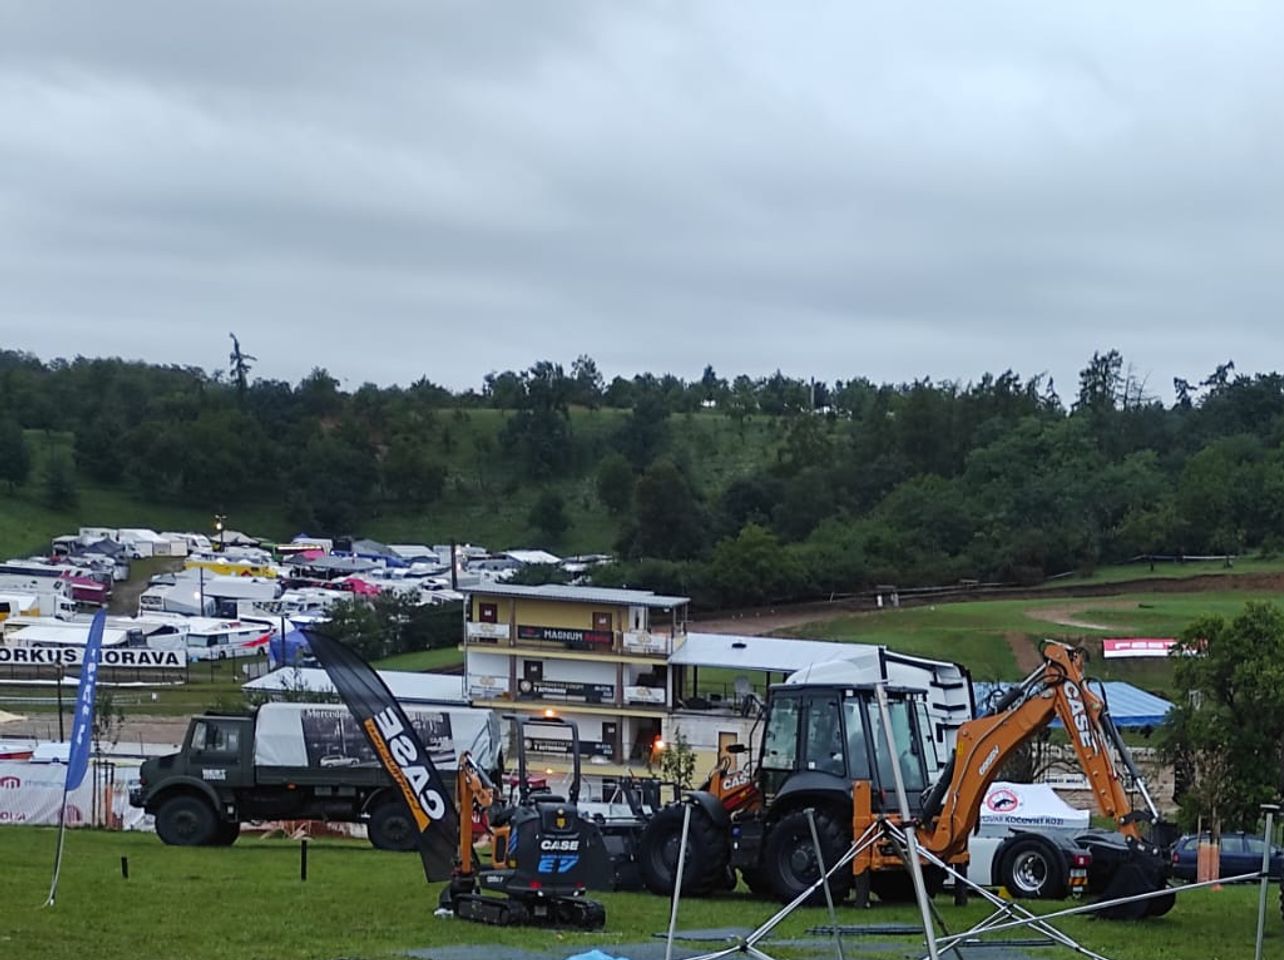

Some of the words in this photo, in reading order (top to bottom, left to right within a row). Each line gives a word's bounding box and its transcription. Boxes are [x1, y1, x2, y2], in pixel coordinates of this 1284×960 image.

[99, 650, 179, 665] ORAVA
[1063, 680, 1094, 748] CASE
[541, 840, 580, 850] CASE
